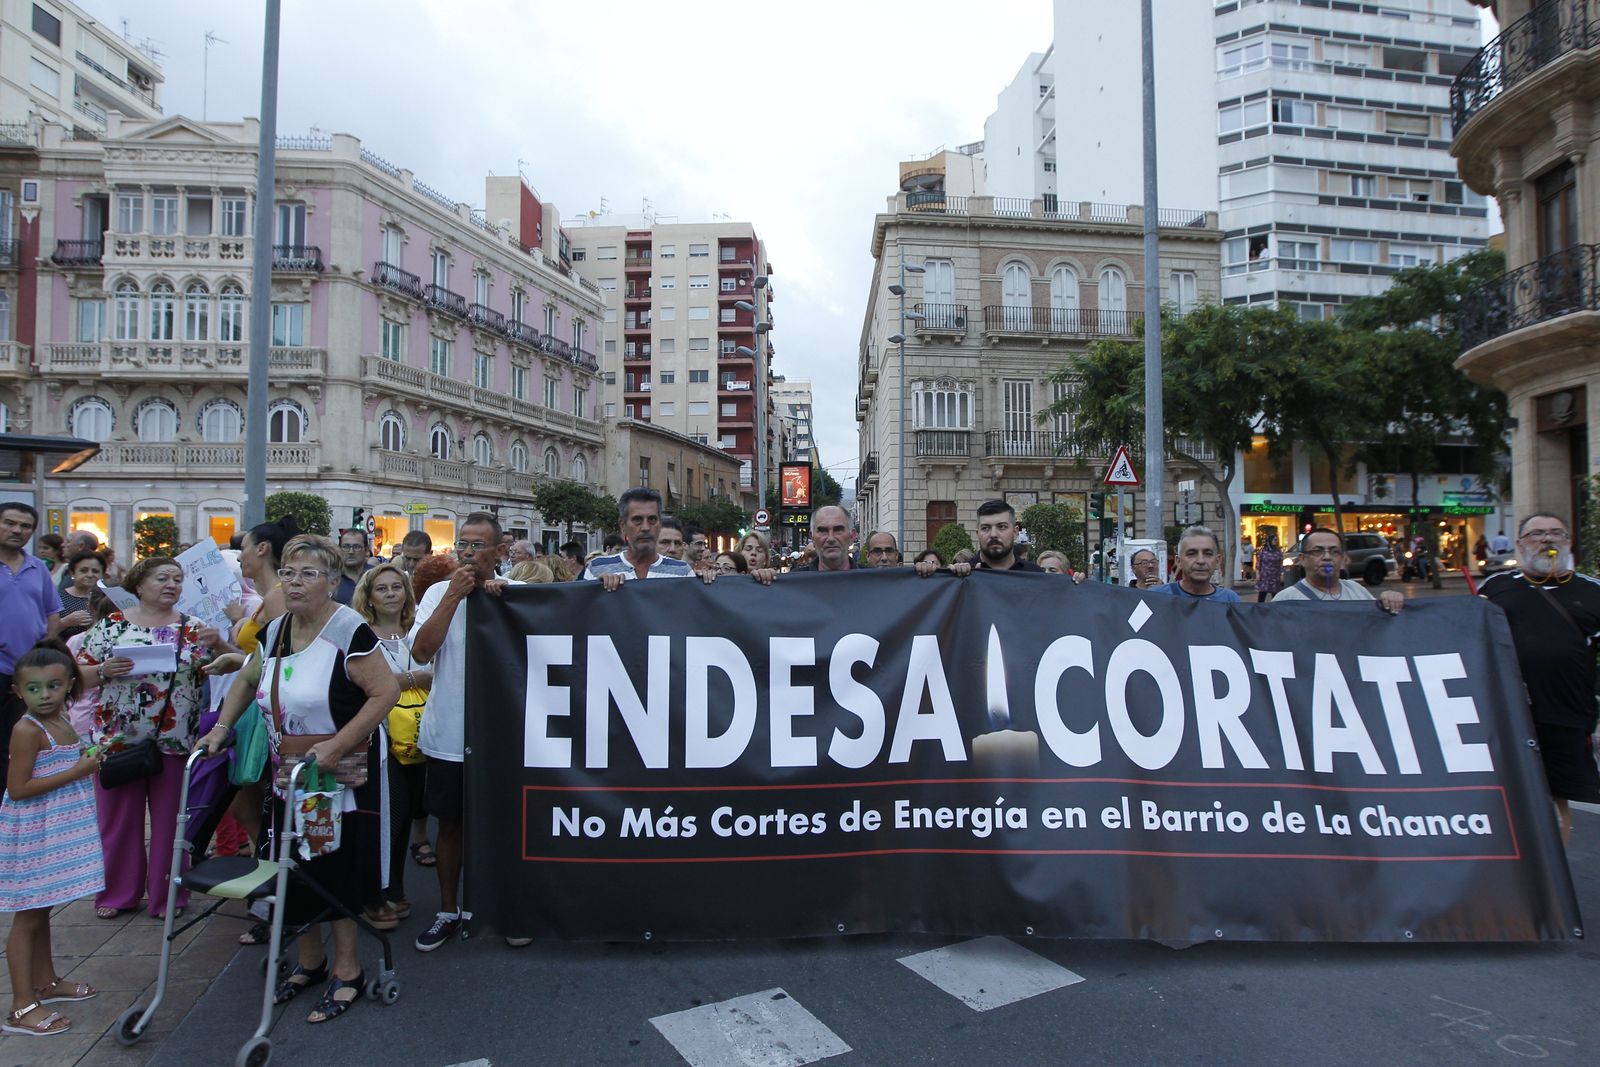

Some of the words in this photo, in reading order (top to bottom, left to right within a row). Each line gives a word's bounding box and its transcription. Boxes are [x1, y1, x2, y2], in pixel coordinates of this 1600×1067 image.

[523, 634, 968, 769] ENDESA
[1034, 598, 1495, 775] CÓRTATE
[552, 806, 606, 837] No
[619, 805, 698, 838] Más
[710, 806, 827, 837] Cortes
[839, 799, 882, 833] de
[894, 796, 1028, 838] Energía
[1041, 806, 1087, 830] en
[1100, 795, 1132, 830] el
[1141, 799, 1250, 834] Barrio
[1261, 800, 1307, 835] de
[1314, 804, 1352, 836] La
[1358, 804, 1493, 838] Chanca
